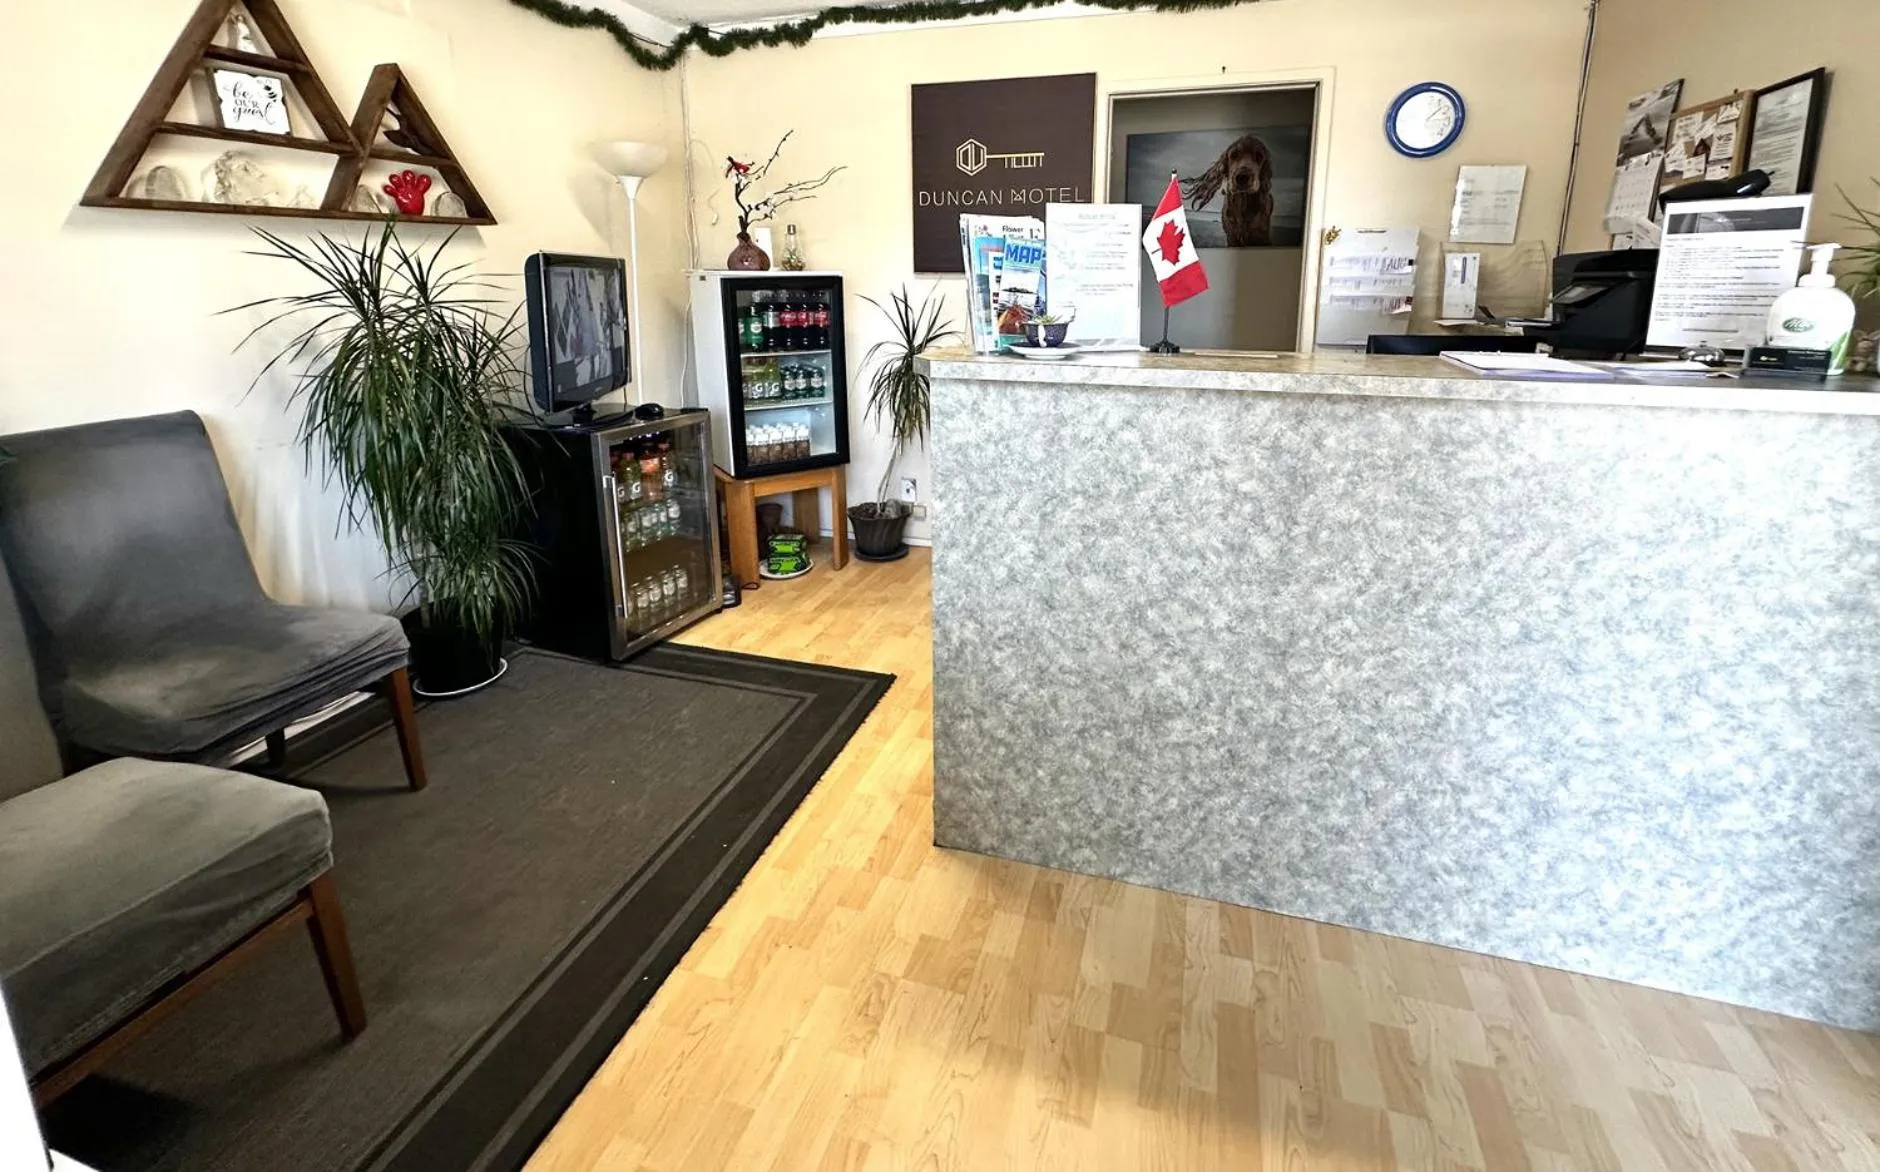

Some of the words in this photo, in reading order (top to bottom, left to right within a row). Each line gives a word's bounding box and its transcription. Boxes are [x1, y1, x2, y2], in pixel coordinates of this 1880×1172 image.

[918, 190, 1002, 206] DUNCAN
[1010, 186, 1085, 204] MOTEL
[1002, 225, 1024, 233] Flower
[1005, 243, 1042, 264] MAP
